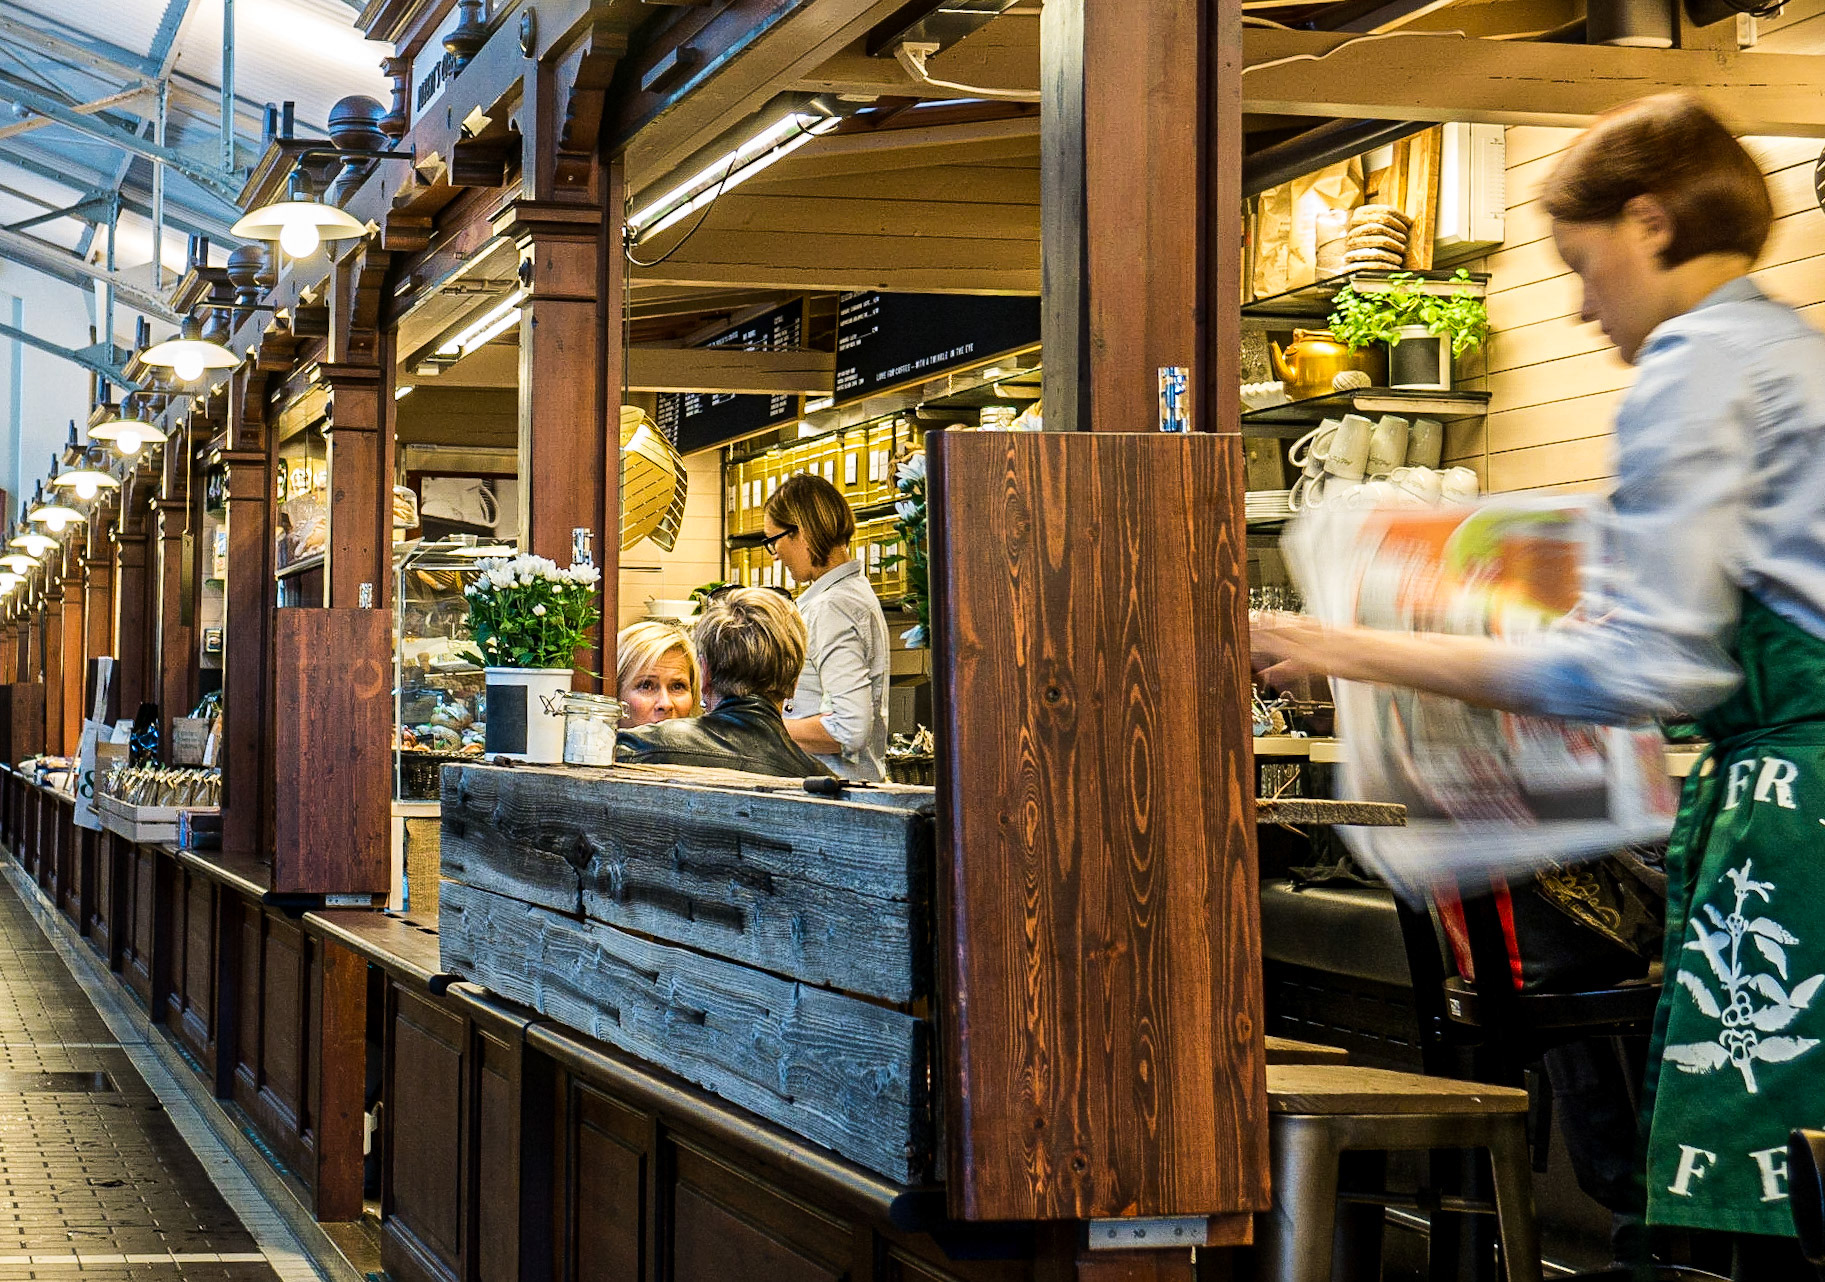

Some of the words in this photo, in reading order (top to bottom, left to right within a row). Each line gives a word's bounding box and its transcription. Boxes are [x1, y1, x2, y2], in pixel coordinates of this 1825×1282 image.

[876, 371, 887, 382] LOVE
[895, 363, 911, 376] COFFEE
[956, 345, 964, 356] THE
[965, 342, 974, 353] EYE
